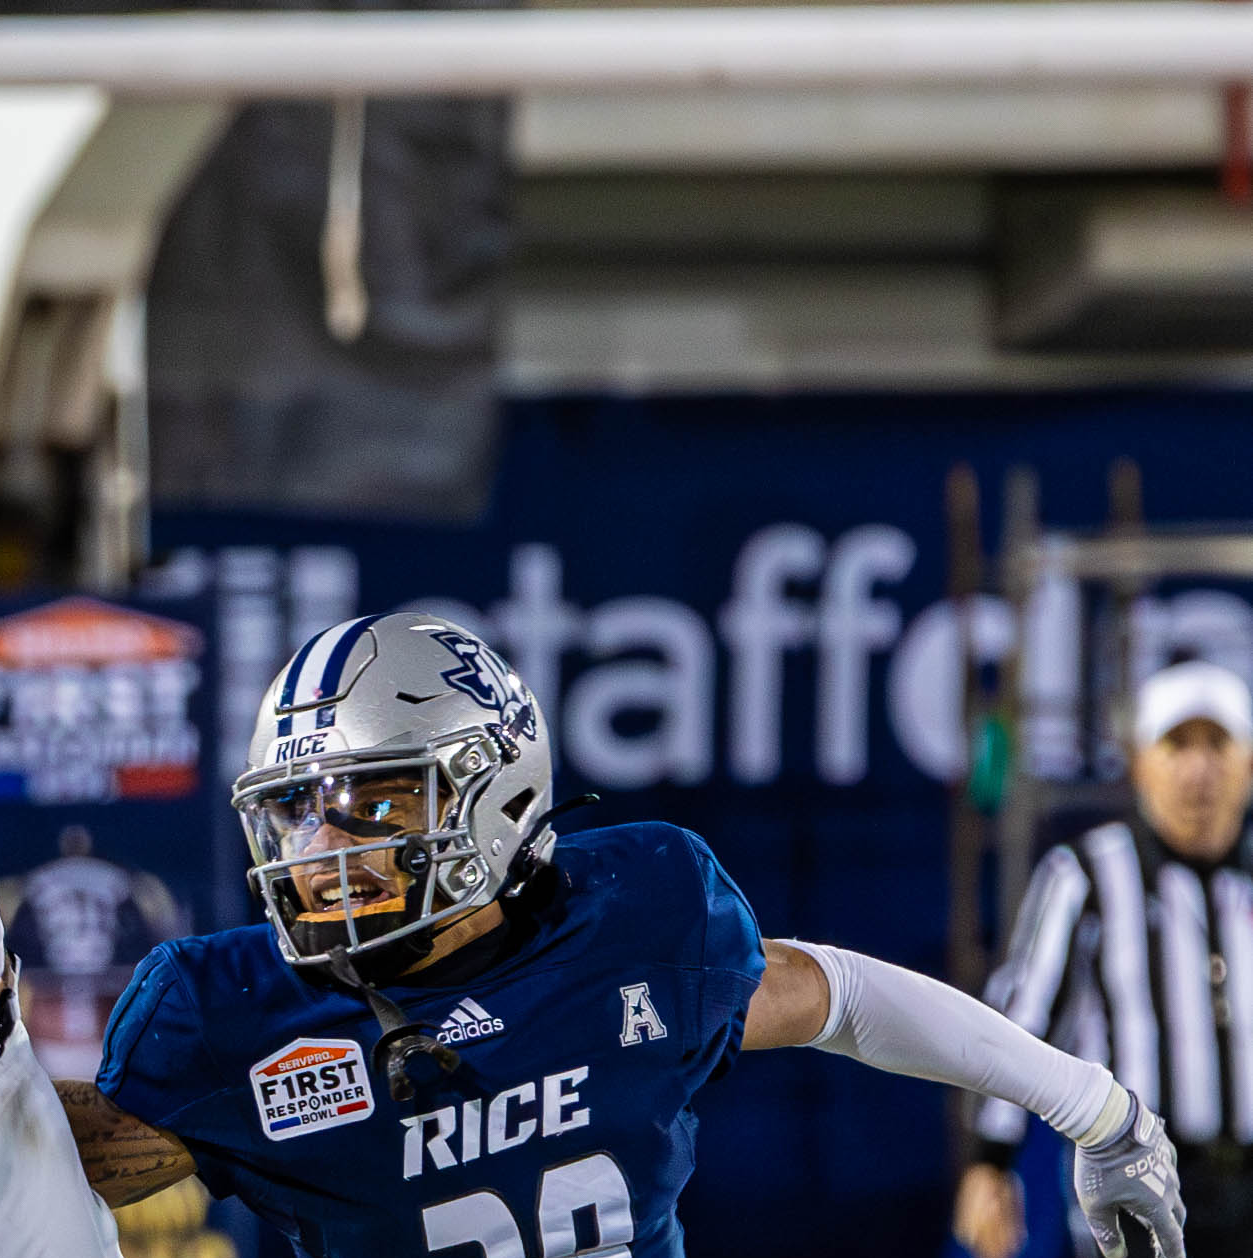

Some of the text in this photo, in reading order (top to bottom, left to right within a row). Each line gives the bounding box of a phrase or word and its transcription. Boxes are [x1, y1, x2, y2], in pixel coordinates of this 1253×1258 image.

[275, 732, 330, 764] RICE
[436, 1016, 505, 1045] adidas
[265, 1085, 365, 1120] RESPONDER
[301, 1108, 337, 1125] BOWL
[399, 1065, 592, 1182] RICE
